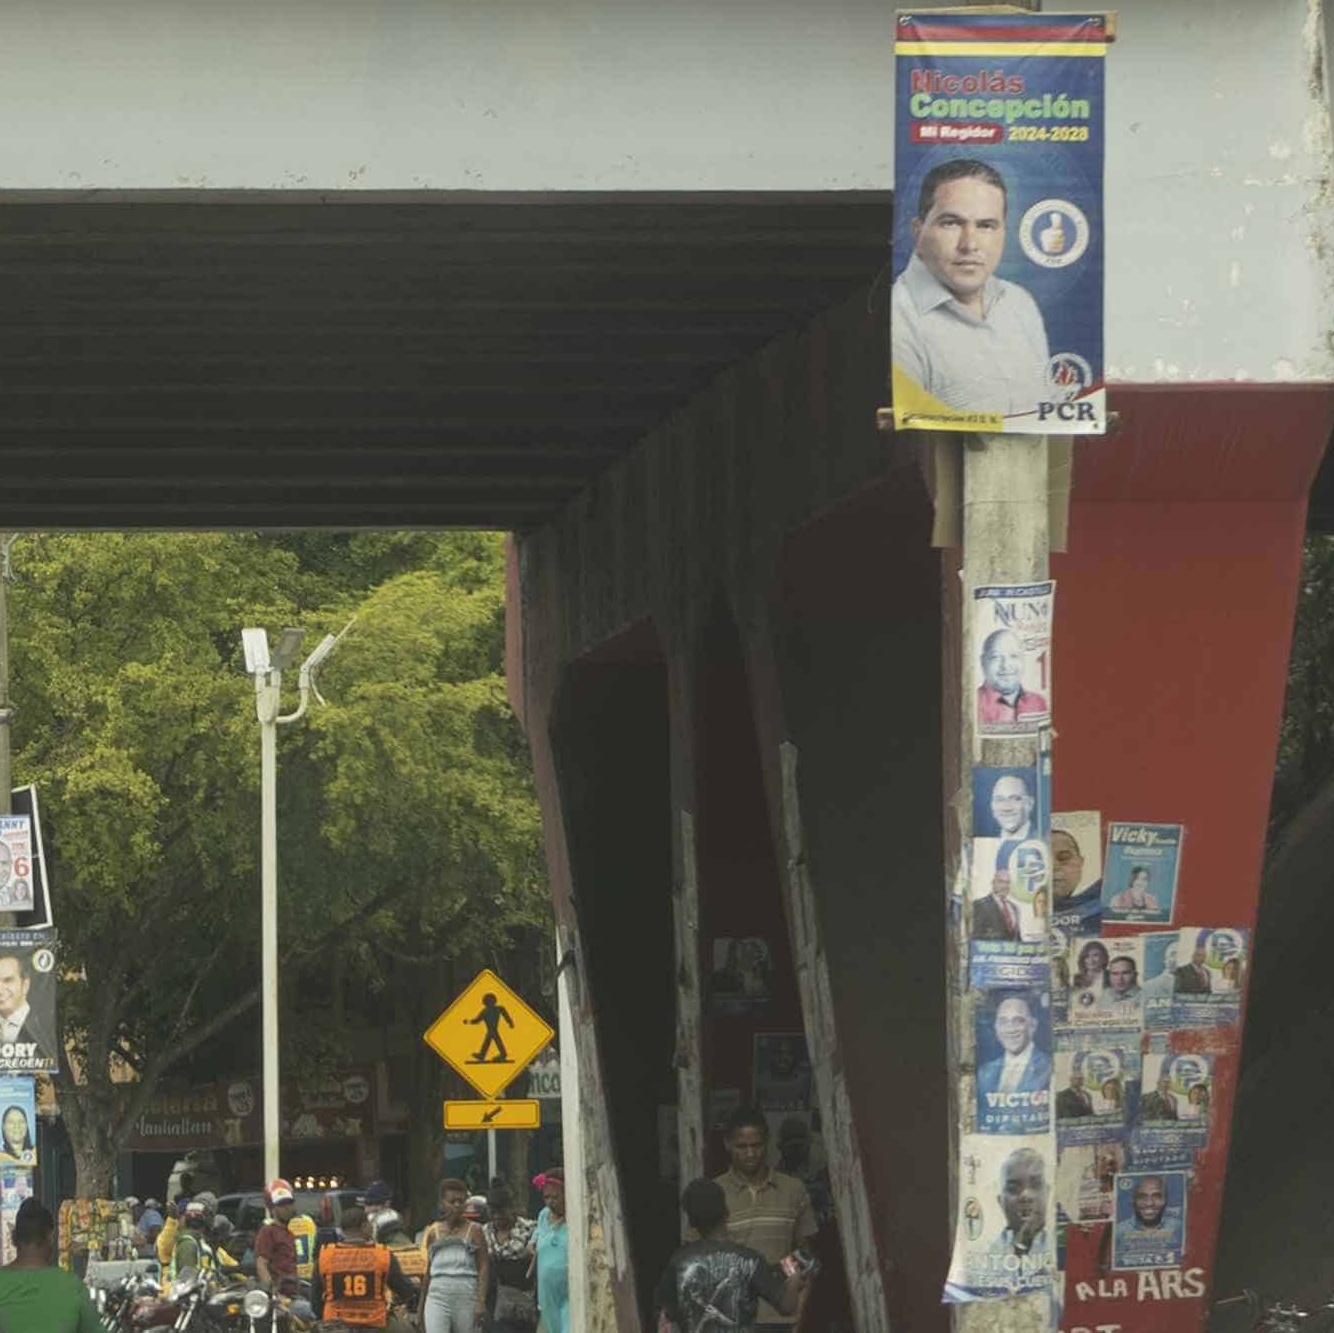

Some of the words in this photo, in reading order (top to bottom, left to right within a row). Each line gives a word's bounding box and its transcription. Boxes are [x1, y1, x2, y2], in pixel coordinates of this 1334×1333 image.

[910, 68, 1026, 95] Nicolás
[910, 92, 1090, 124] Concepción
[919, 125, 938, 139] Mi
[940, 125, 996, 142] Regidor
[1007, 126, 1089, 142] 2024-2028
[1037, 401, 1096, 421] PCR
[1111, 826, 1159, 847] Vicky
[13, 857, 30, 878] 6
[1098, 1278, 1129, 1298] LA
[1136, 1266, 1207, 1302] ARS
